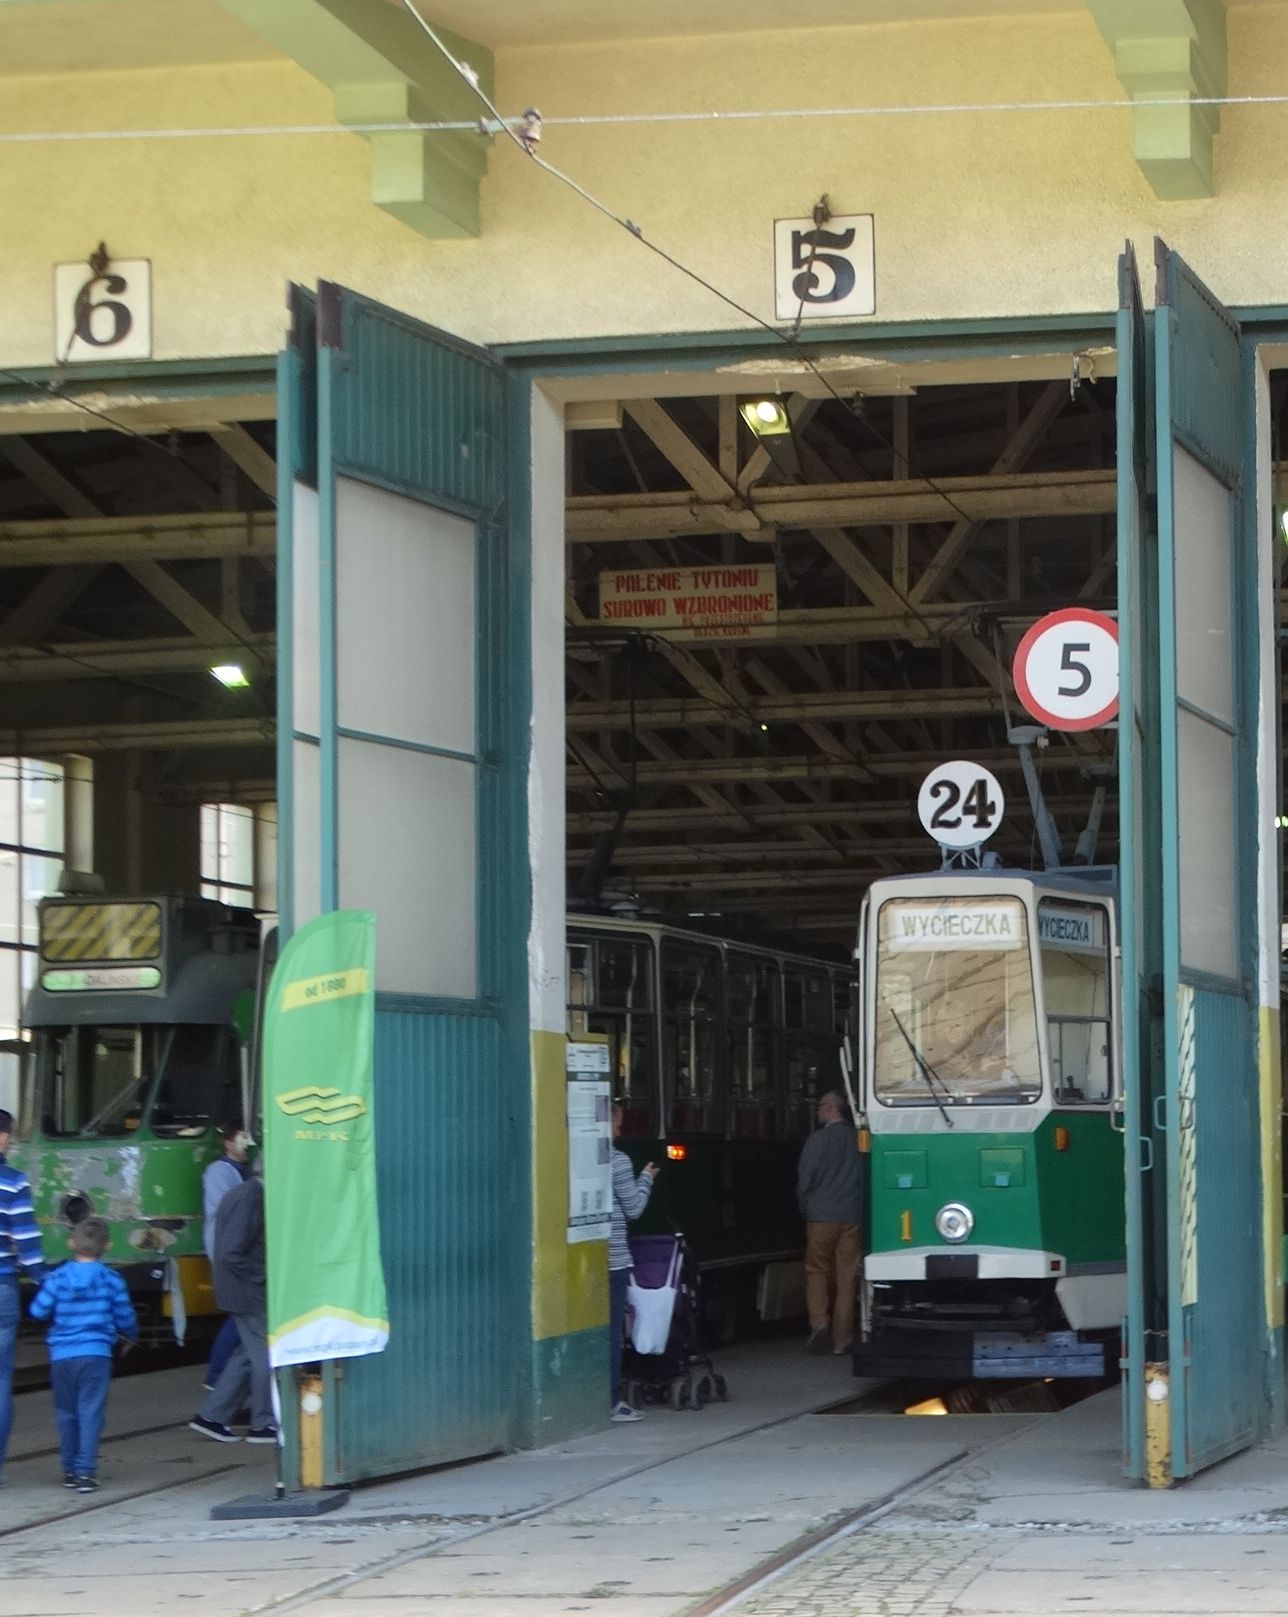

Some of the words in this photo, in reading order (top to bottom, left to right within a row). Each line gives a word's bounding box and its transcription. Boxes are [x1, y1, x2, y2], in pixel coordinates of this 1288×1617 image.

[791, 227, 856, 304] 5
[74, 273, 132, 347] 6
[615, 572, 681, 593] PALENIE
[603, 599, 667, 619] SUROWO
[673, 593, 774, 615] WZBRONIONE
[1058, 643, 1092, 697] 5
[930, 779, 996, 829] 24
[902, 913, 1012, 937] WYCIECZKA
[902, 1210, 912, 1241] 1
